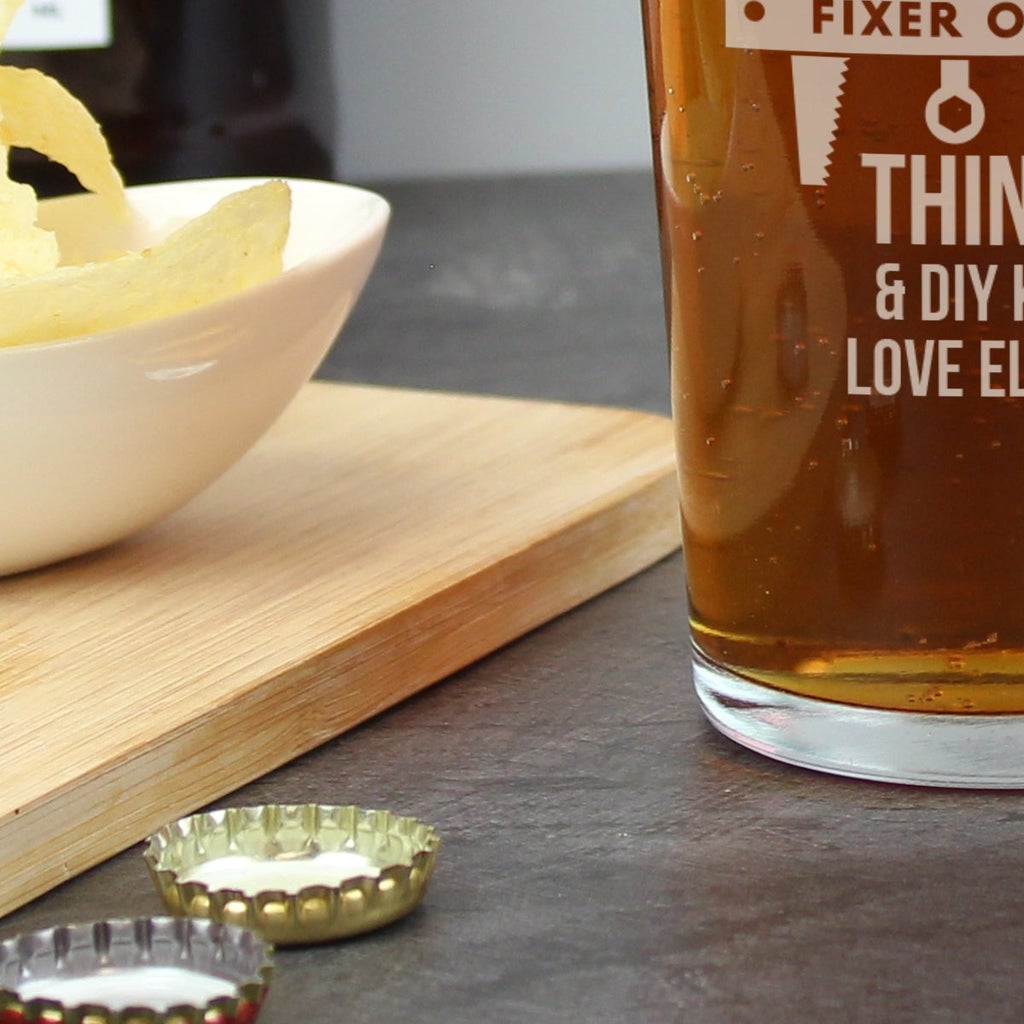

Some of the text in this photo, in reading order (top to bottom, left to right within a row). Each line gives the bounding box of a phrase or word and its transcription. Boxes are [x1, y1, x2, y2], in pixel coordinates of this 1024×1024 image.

[876, 263, 905, 321] &
[920, 264, 998, 321] DIY
[847, 338, 962, 397] LOVE
